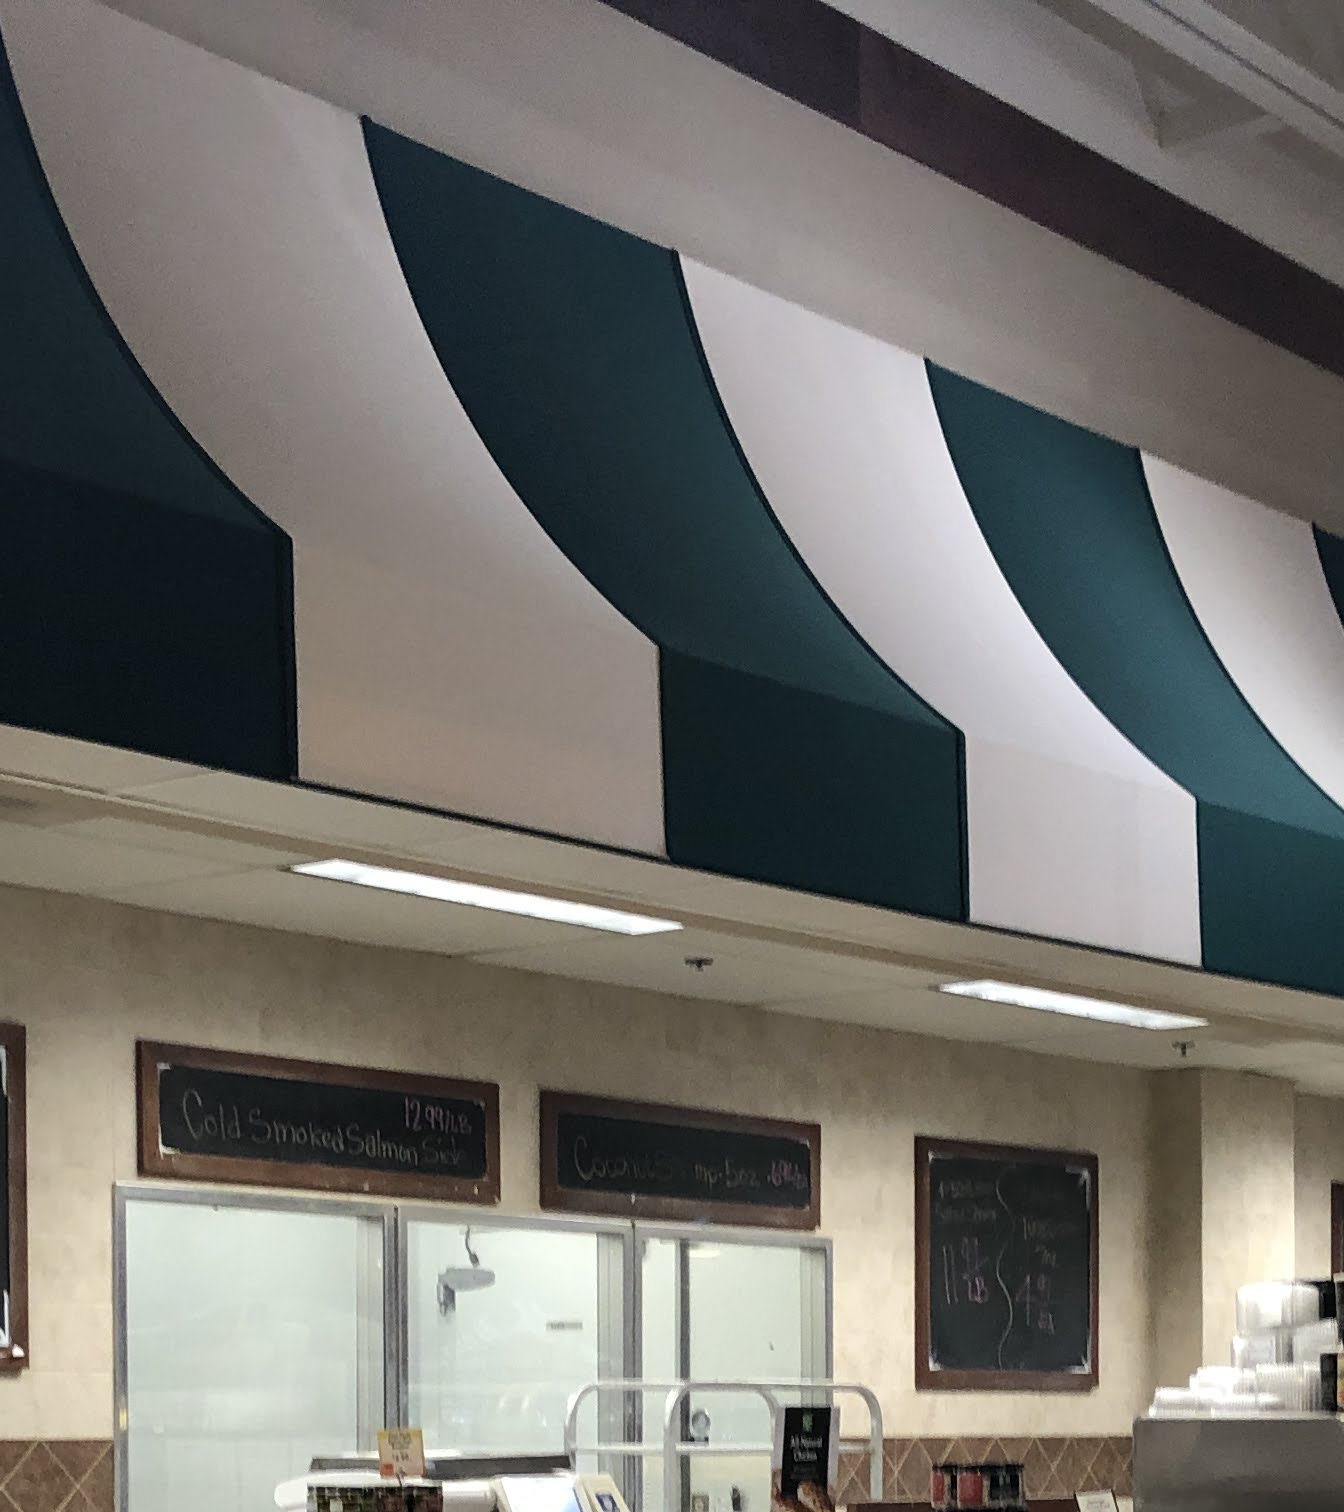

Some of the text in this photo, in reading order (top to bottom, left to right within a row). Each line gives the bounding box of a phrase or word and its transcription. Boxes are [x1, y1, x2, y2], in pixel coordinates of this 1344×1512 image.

[182, 1087, 241, 1142] Cold
[248, 1107, 346, 1154] Smoked
[346, 1121, 420, 1167] Salmon
